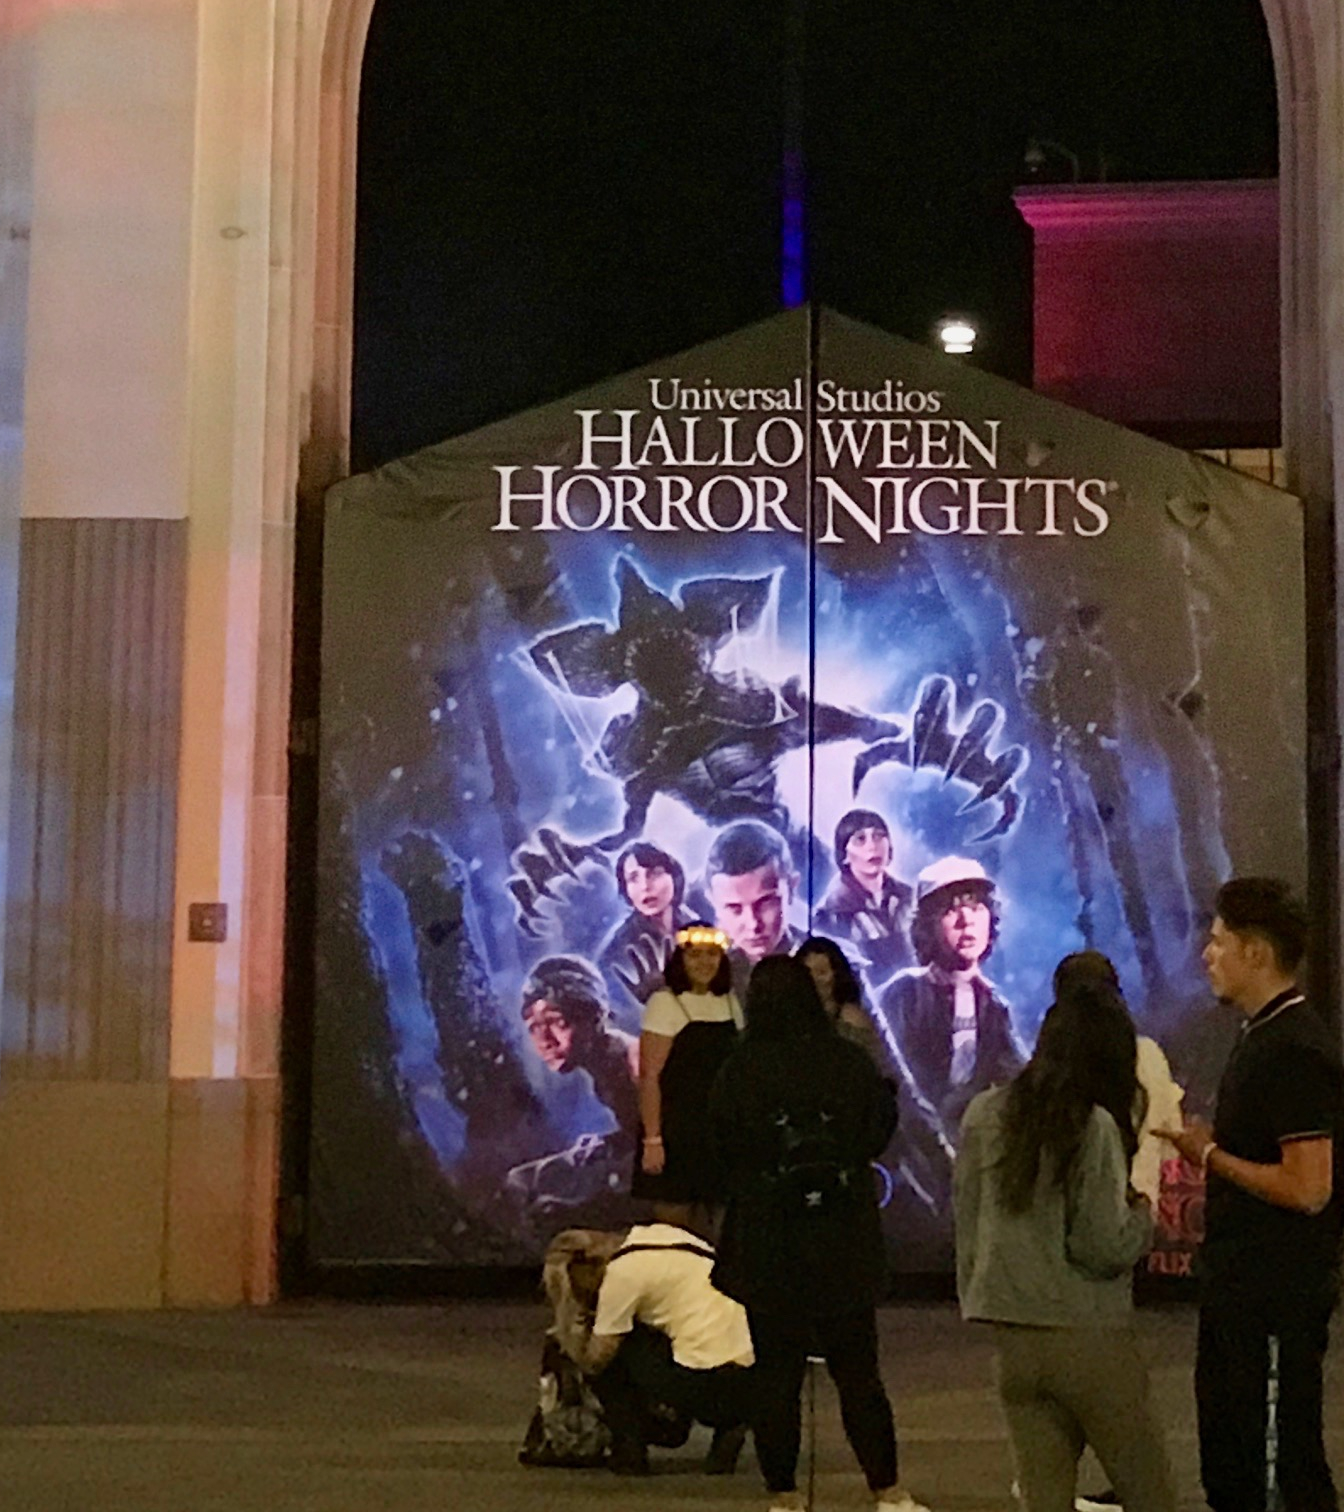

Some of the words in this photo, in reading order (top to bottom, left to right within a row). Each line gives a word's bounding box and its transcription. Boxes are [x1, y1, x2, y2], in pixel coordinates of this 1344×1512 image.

[648, 378, 804, 411] Universal
[816, 379, 942, 413] Studios
[573, 409, 1002, 471] HALLOWEEN
[490, 465, 804, 532] HORROR
[815, 476, 1110, 545] NIGHTS
